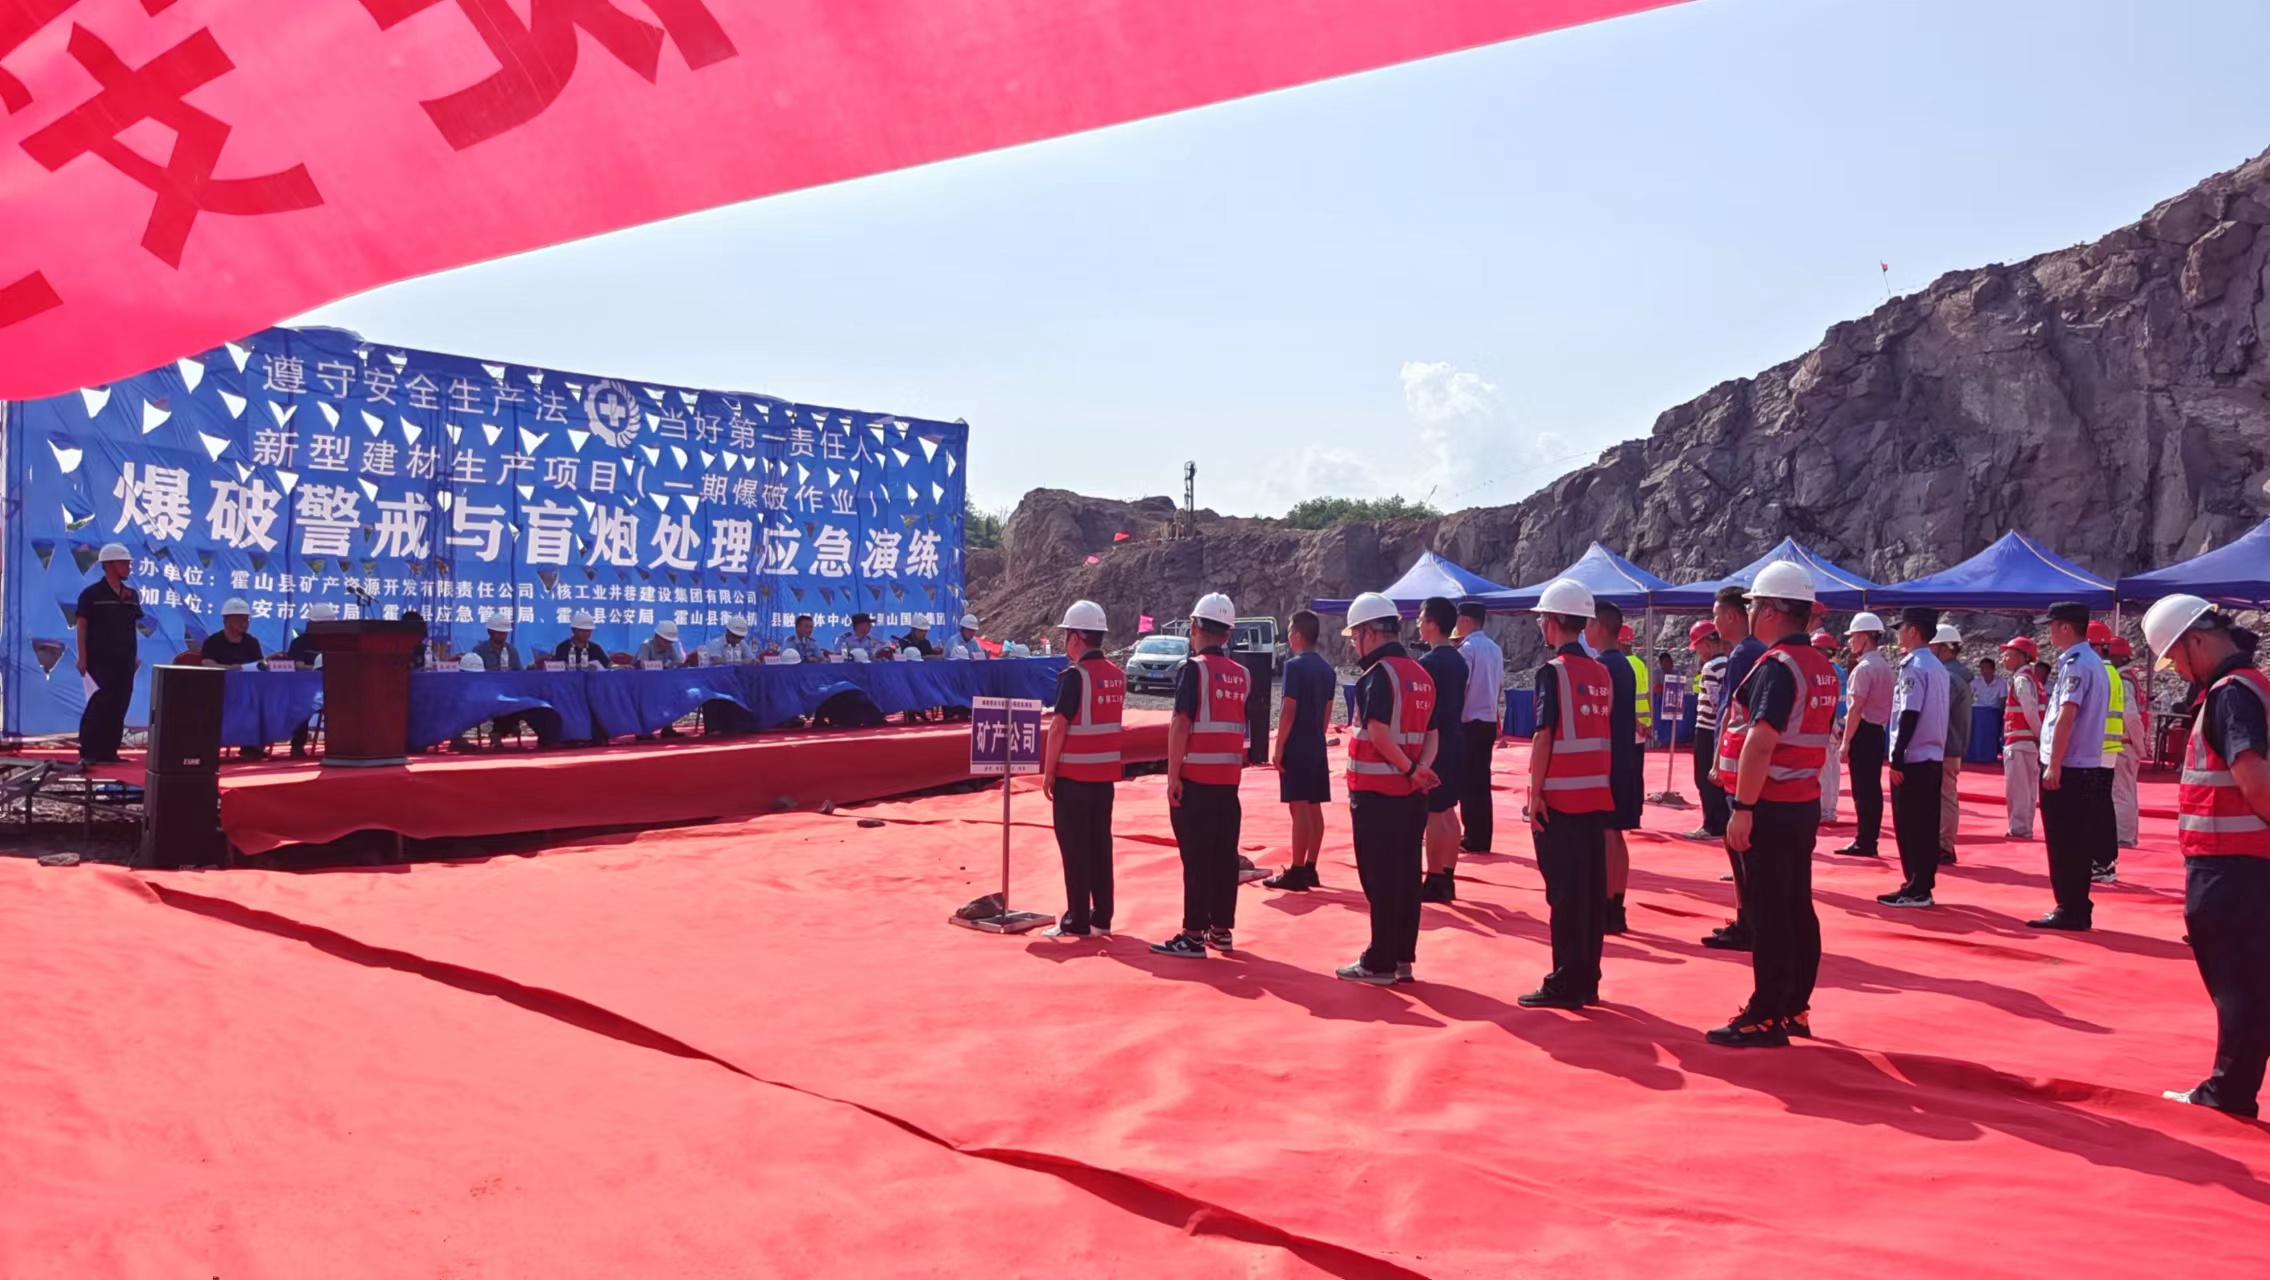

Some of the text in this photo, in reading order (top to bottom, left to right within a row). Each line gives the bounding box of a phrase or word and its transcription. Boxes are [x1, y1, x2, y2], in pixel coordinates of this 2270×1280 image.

[262, 353, 568, 424] 遵守安全生产法
[660, 407, 873, 464] 当好第一责任人
[113, 461, 942, 579] 爆破警戒与盲炮处理应急演练
[977, 720, 1035, 754] 矿产公司
